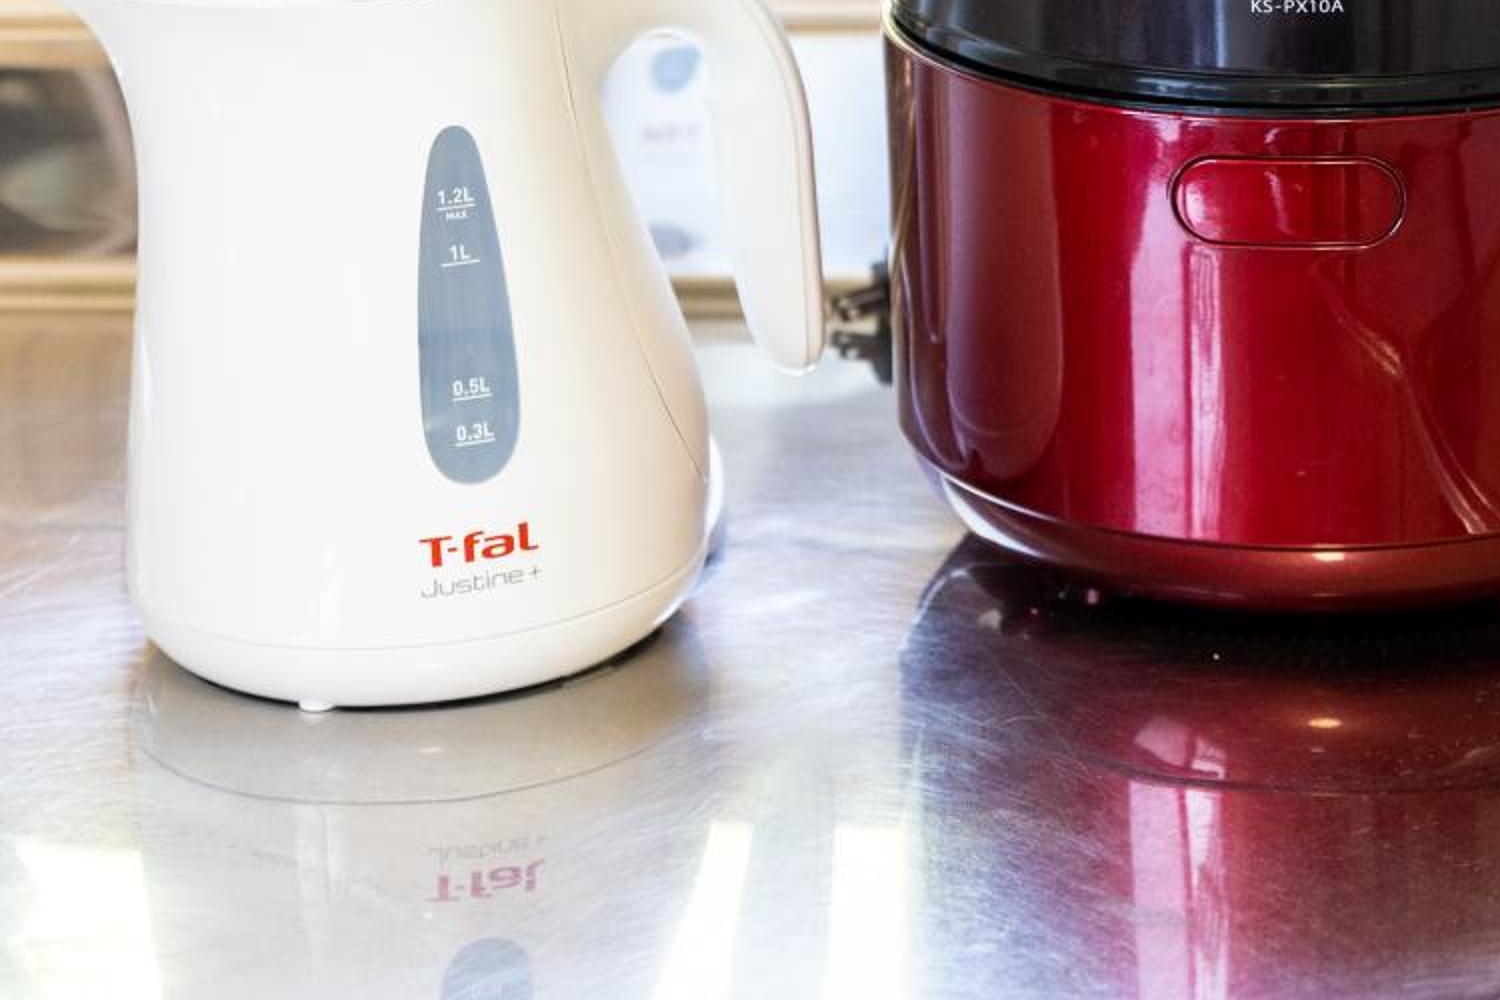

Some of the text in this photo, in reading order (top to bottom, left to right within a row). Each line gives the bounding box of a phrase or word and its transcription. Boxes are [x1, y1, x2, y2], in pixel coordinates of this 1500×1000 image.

[437, 186, 475, 206] 1.2L
[449, 243, 472, 261] 1L
[452, 376, 492, 397] 0.5L
[456, 421, 495, 442] 0.3L
[418, 521, 540, 568] T-fal
